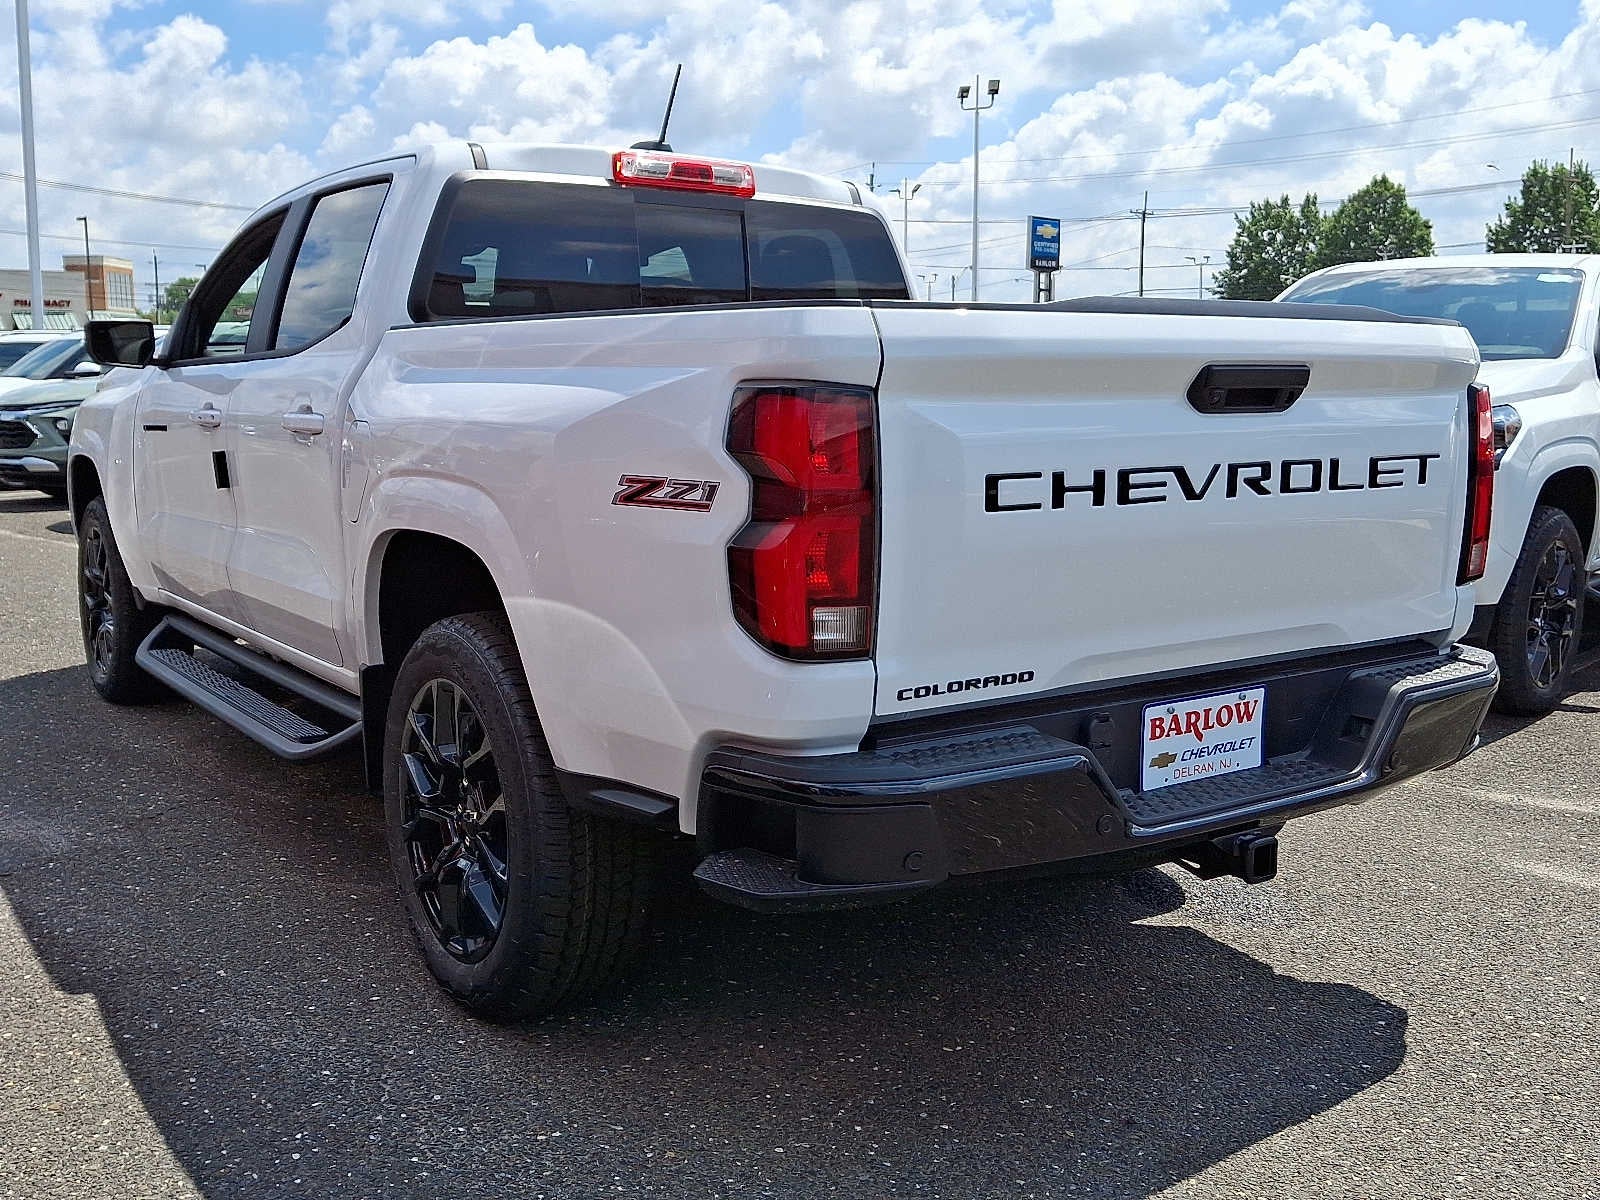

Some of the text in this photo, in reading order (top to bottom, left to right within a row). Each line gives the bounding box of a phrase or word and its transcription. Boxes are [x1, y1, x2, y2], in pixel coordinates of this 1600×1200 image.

[14, 299, 71, 308] PHMACY
[611, 474, 721, 513] Z71
[984, 454, 1441, 513] CHEVROLET
[897, 670, 1035, 702] COLORADO
[1149, 699, 1259, 742] BARLOW
[1180, 736, 1256, 762] CHEVROLET
[1173, 758, 1232, 779] DELRAN, NJ
